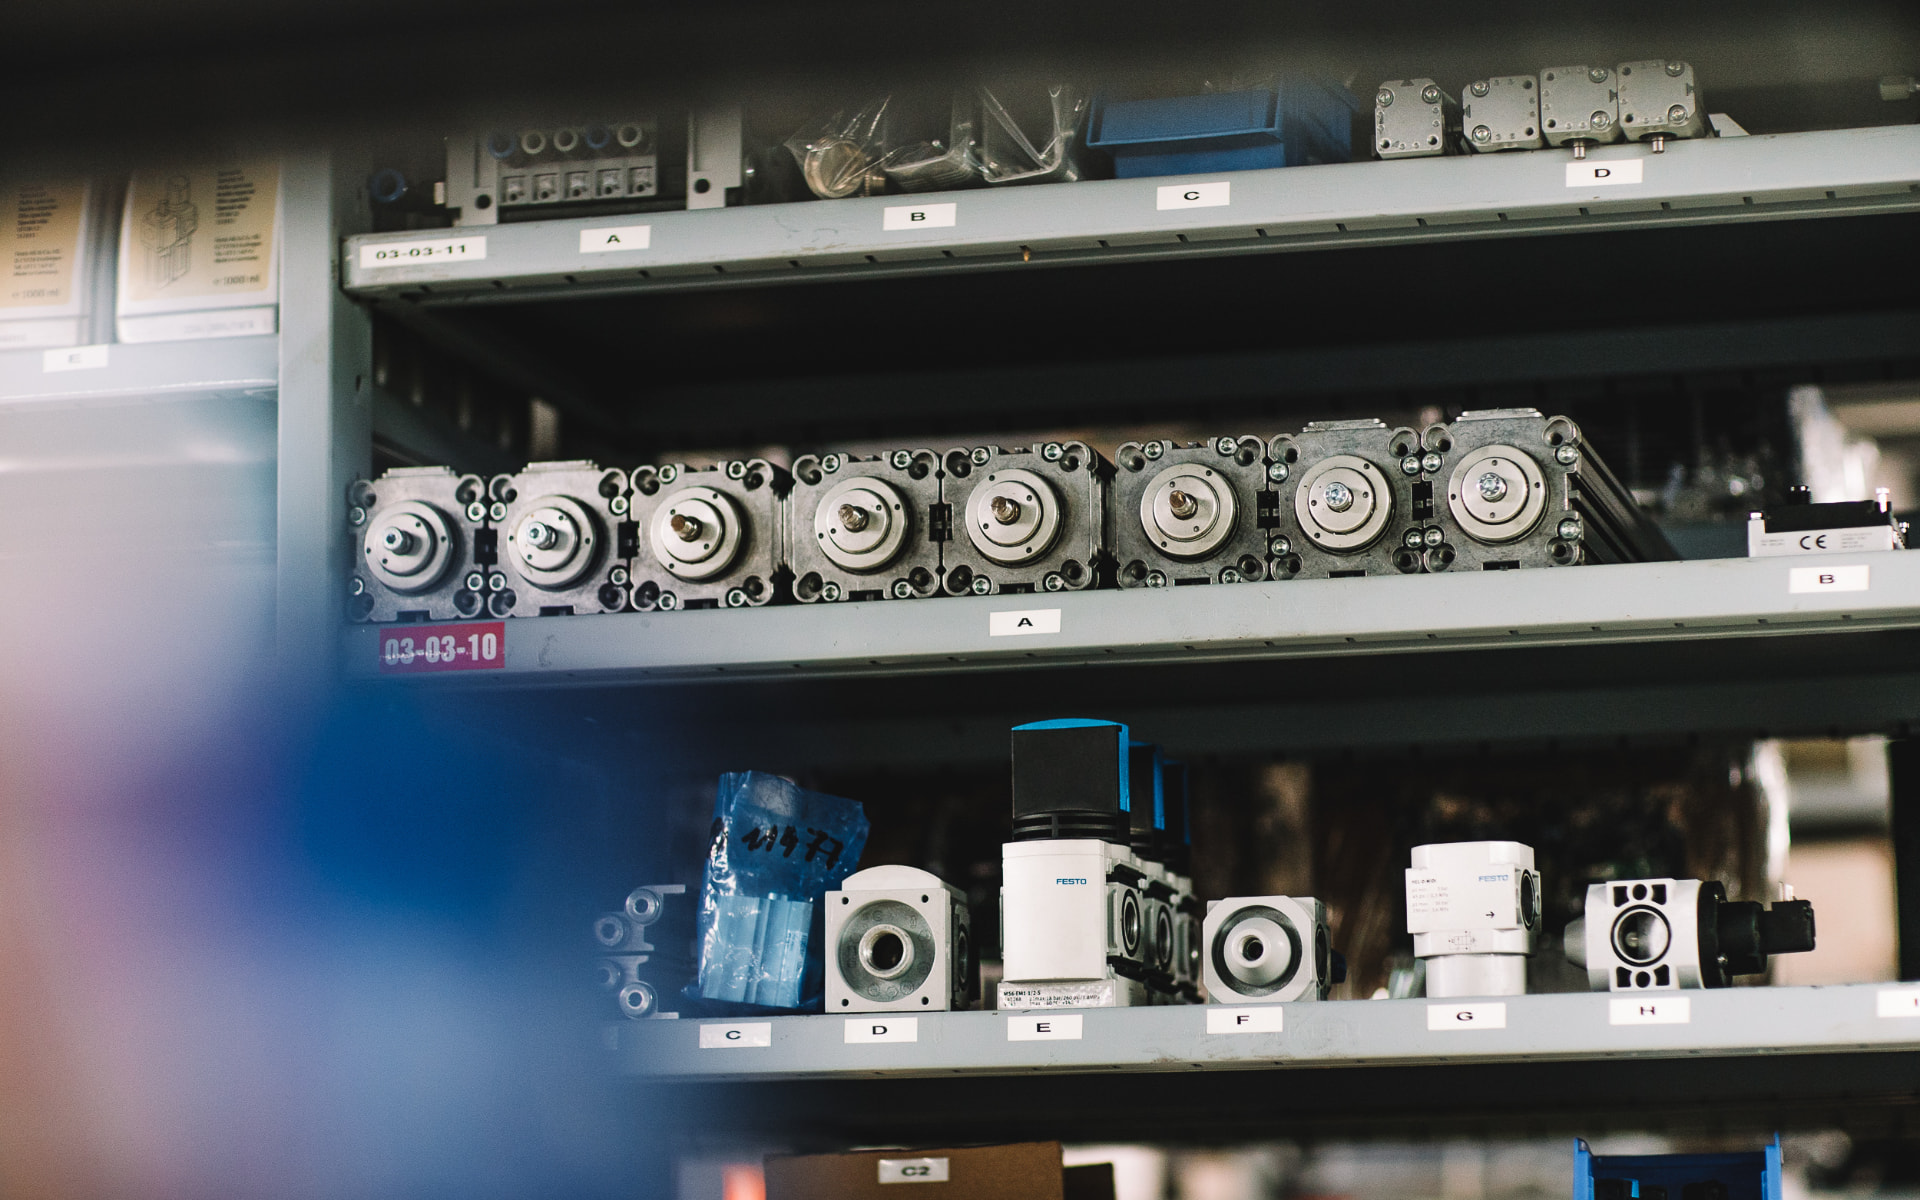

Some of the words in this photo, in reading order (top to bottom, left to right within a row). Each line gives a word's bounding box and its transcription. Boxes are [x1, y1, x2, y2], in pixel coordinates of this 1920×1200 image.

[1594, 168, 1611, 178] D
[1183, 191, 1200, 201] C
[910, 212, 926, 222] B
[606, 234, 620, 244] A
[376, 244, 465, 260] 03-03-11
[1819, 574, 1835, 584] B
[1017, 617, 1034, 628] A
[385, 632, 497, 665] 03-03-10
[1056, 878, 1087, 886] FESTO
[1478, 874, 1509, 882] FESTO
[1456, 1011, 1473, 1021] G
[1640, 1006, 1656, 1016] H
[1236, 1015, 1250, 1025] F
[872, 1025, 888, 1035] D
[1036, 1022, 1051, 1033] E
[725, 1030, 741, 1040] C
[901, 1165, 930, 1177] C2
